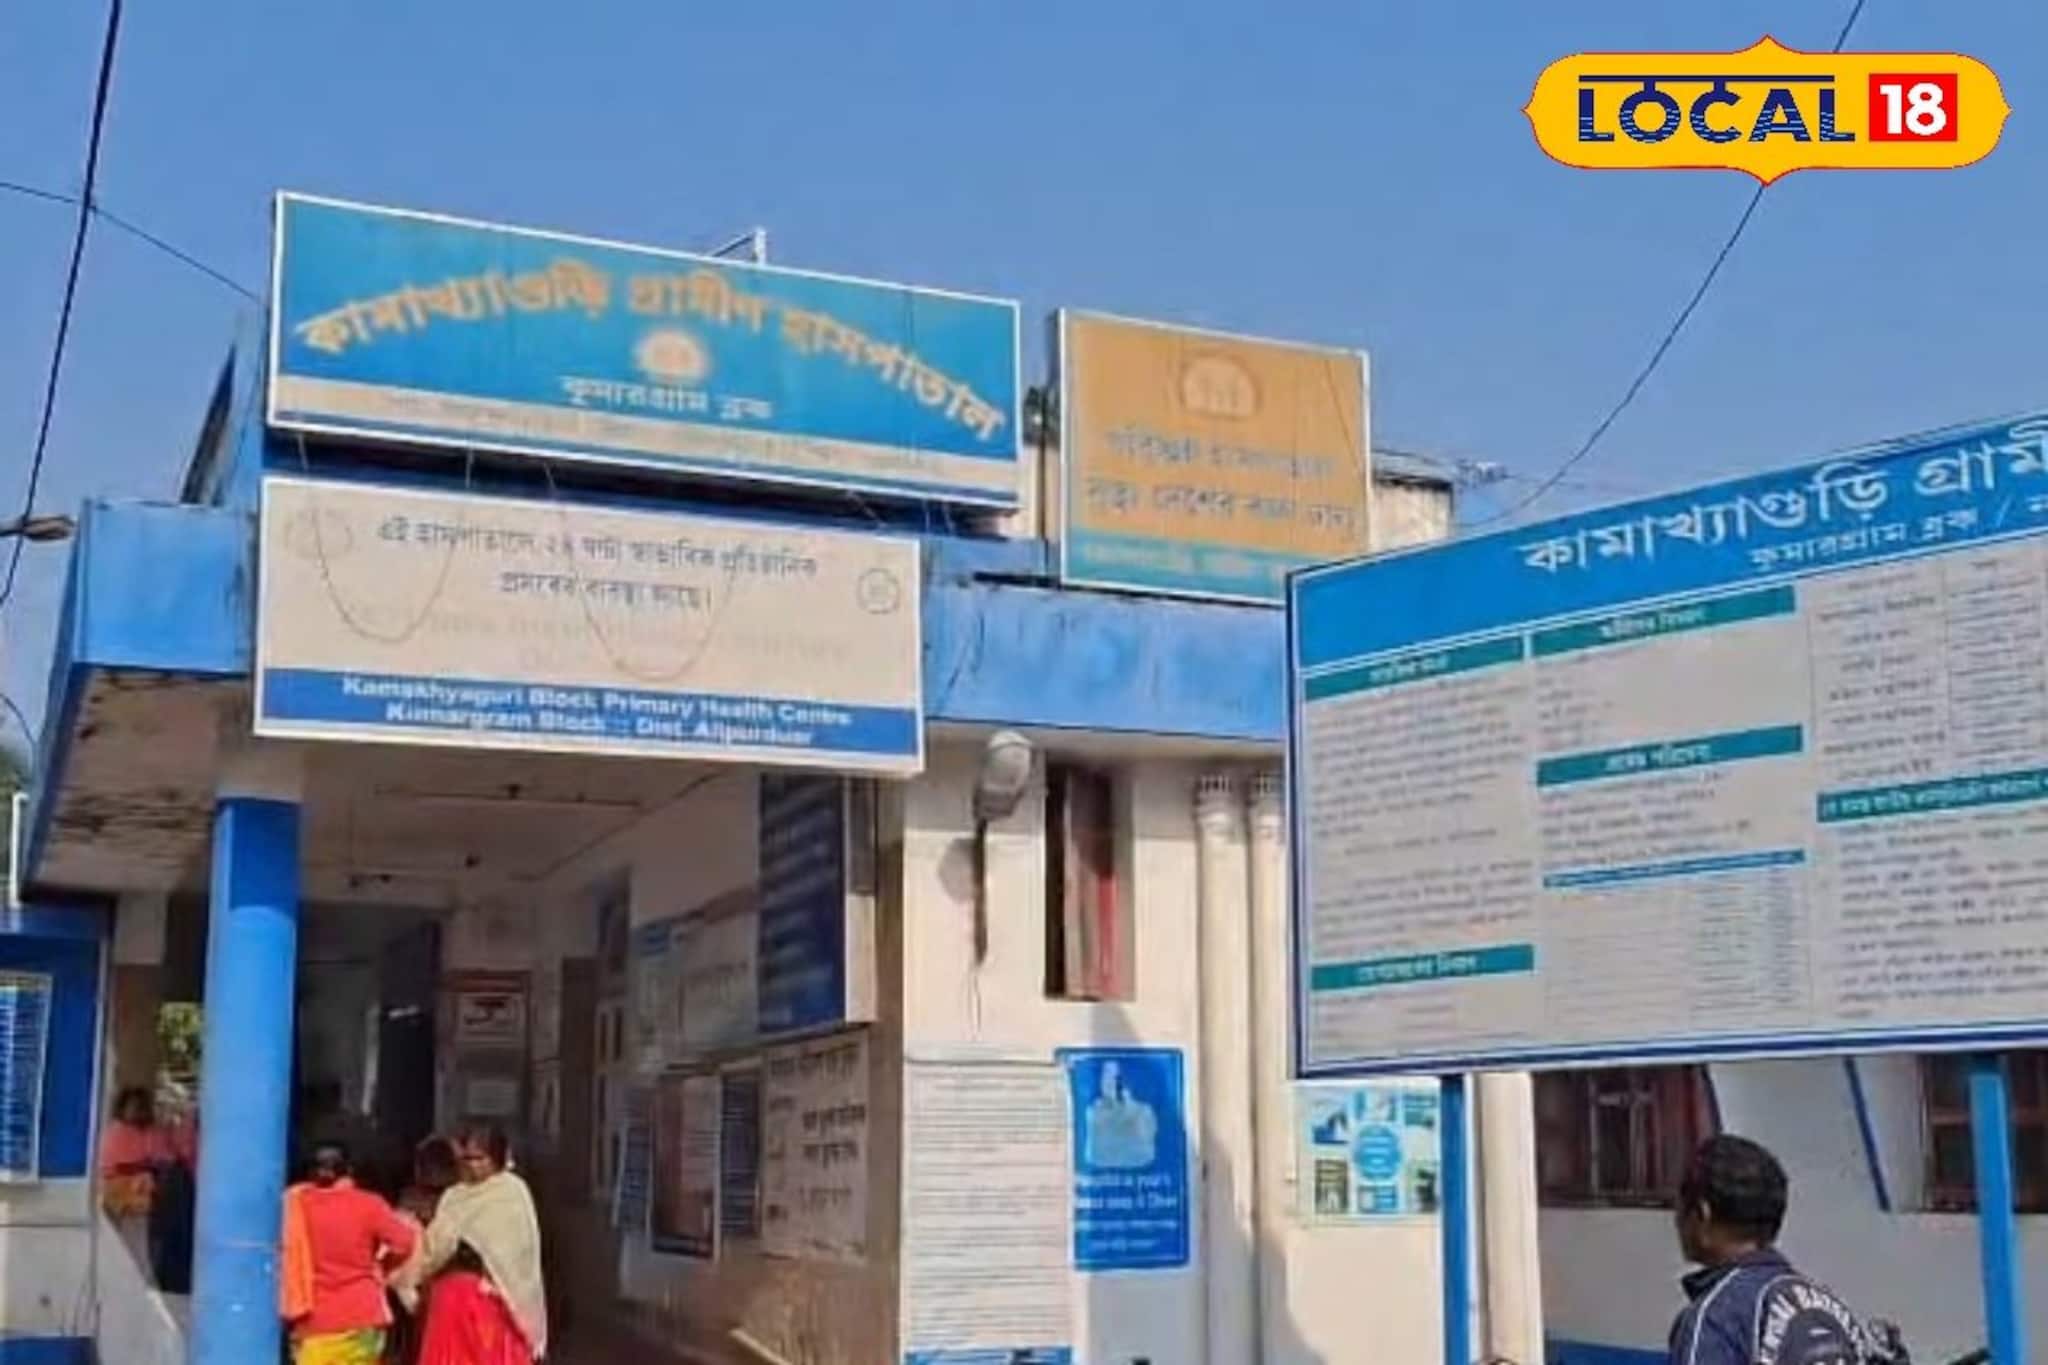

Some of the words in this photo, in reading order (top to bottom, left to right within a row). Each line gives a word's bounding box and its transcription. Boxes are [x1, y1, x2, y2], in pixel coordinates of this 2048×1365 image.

[629, 269, 765, 333] গ্রামীণ
[780, 305, 1006, 441] হাসপাতাল
[1517, 460, 1890, 573] কামাখ্যাগুড়ি
[1748, 522, 1906, 572] কুমারগ্রাম
[529, 687, 600, 710] Block
[603, 693, 694, 719] Primary
[700, 698, 775, 721] Health
[539, 710, 606, 731] Block
